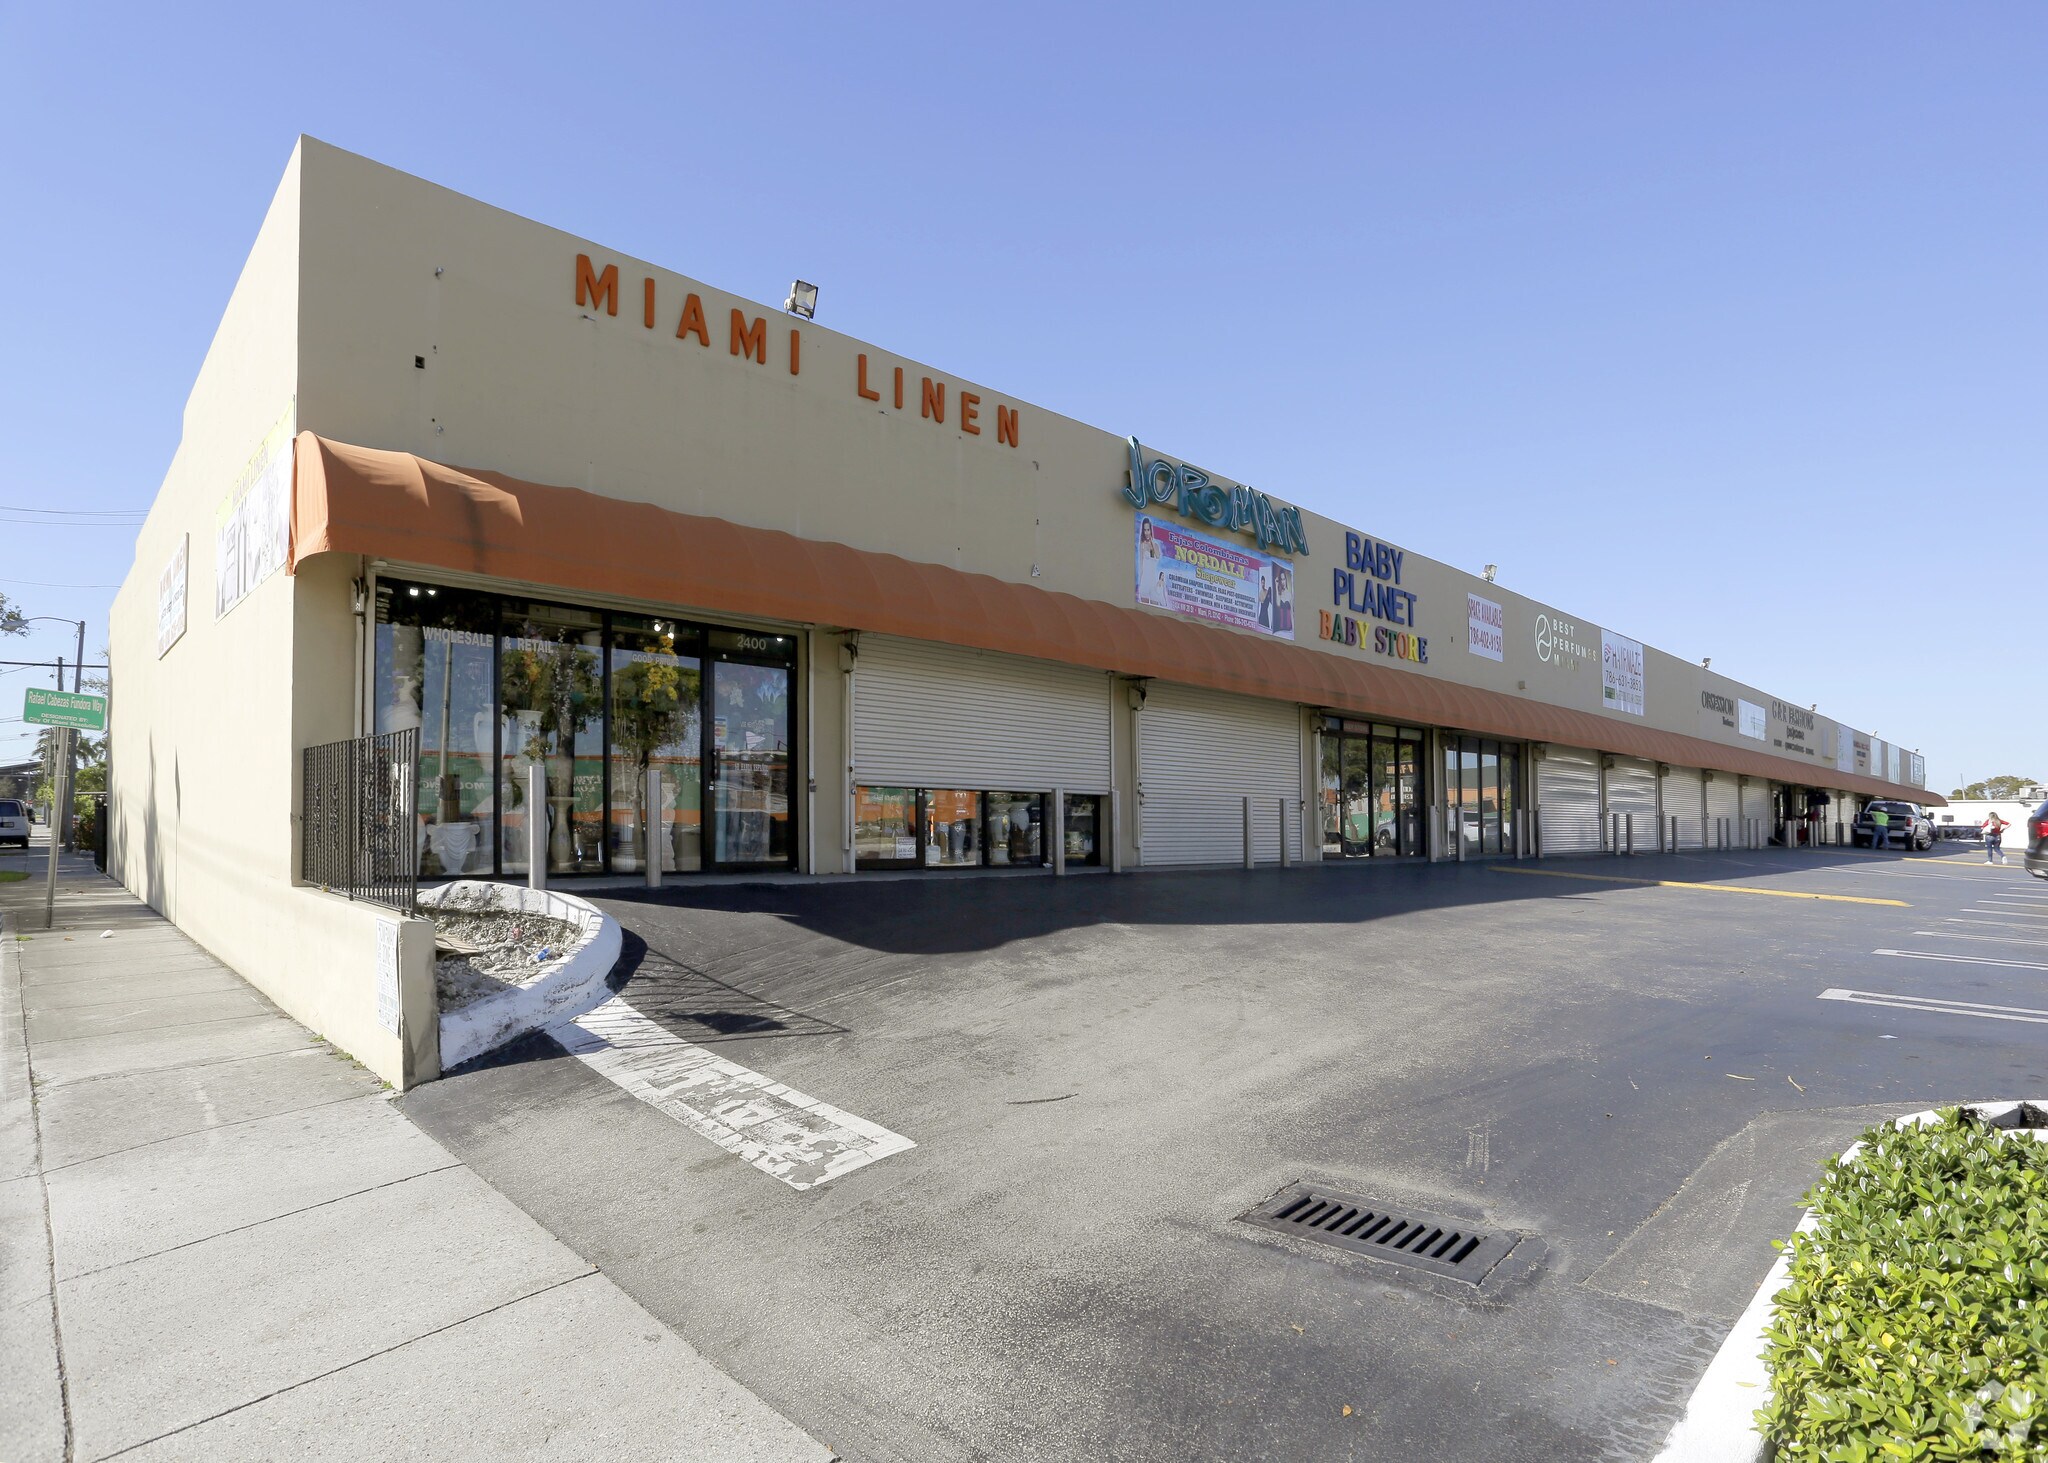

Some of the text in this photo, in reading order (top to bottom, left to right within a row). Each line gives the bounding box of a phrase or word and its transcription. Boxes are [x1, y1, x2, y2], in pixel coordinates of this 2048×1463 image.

[575, 253, 1018, 448] MIAMI LINEN
[1168, 532, 1249, 565] Fajas Colombianas
[1345, 531, 1404, 585] BABY
[1174, 544, 1245, 579] NORDALI
[1196, 567, 1236, 589] Shapewear
[1333, 567, 1417, 627] PLANET
[422, 625, 554, 654] WHOLESALE & RETAIL
[1319, 609, 1428, 664] BABY STORE
[1553, 618, 1574, 637] BEST
[737, 635, 767, 650] 2400
[1553, 636, 1597, 661] PERFUMES
[632, 653, 654, 663] GOOD
[28, 691, 103, 714] Rafael Cabezas Fundora Way
[1701, 690, 1734, 716] OBSESSION
[29, 716, 41, 724] City
[41, 712, 77, 722] DESIGNATED
